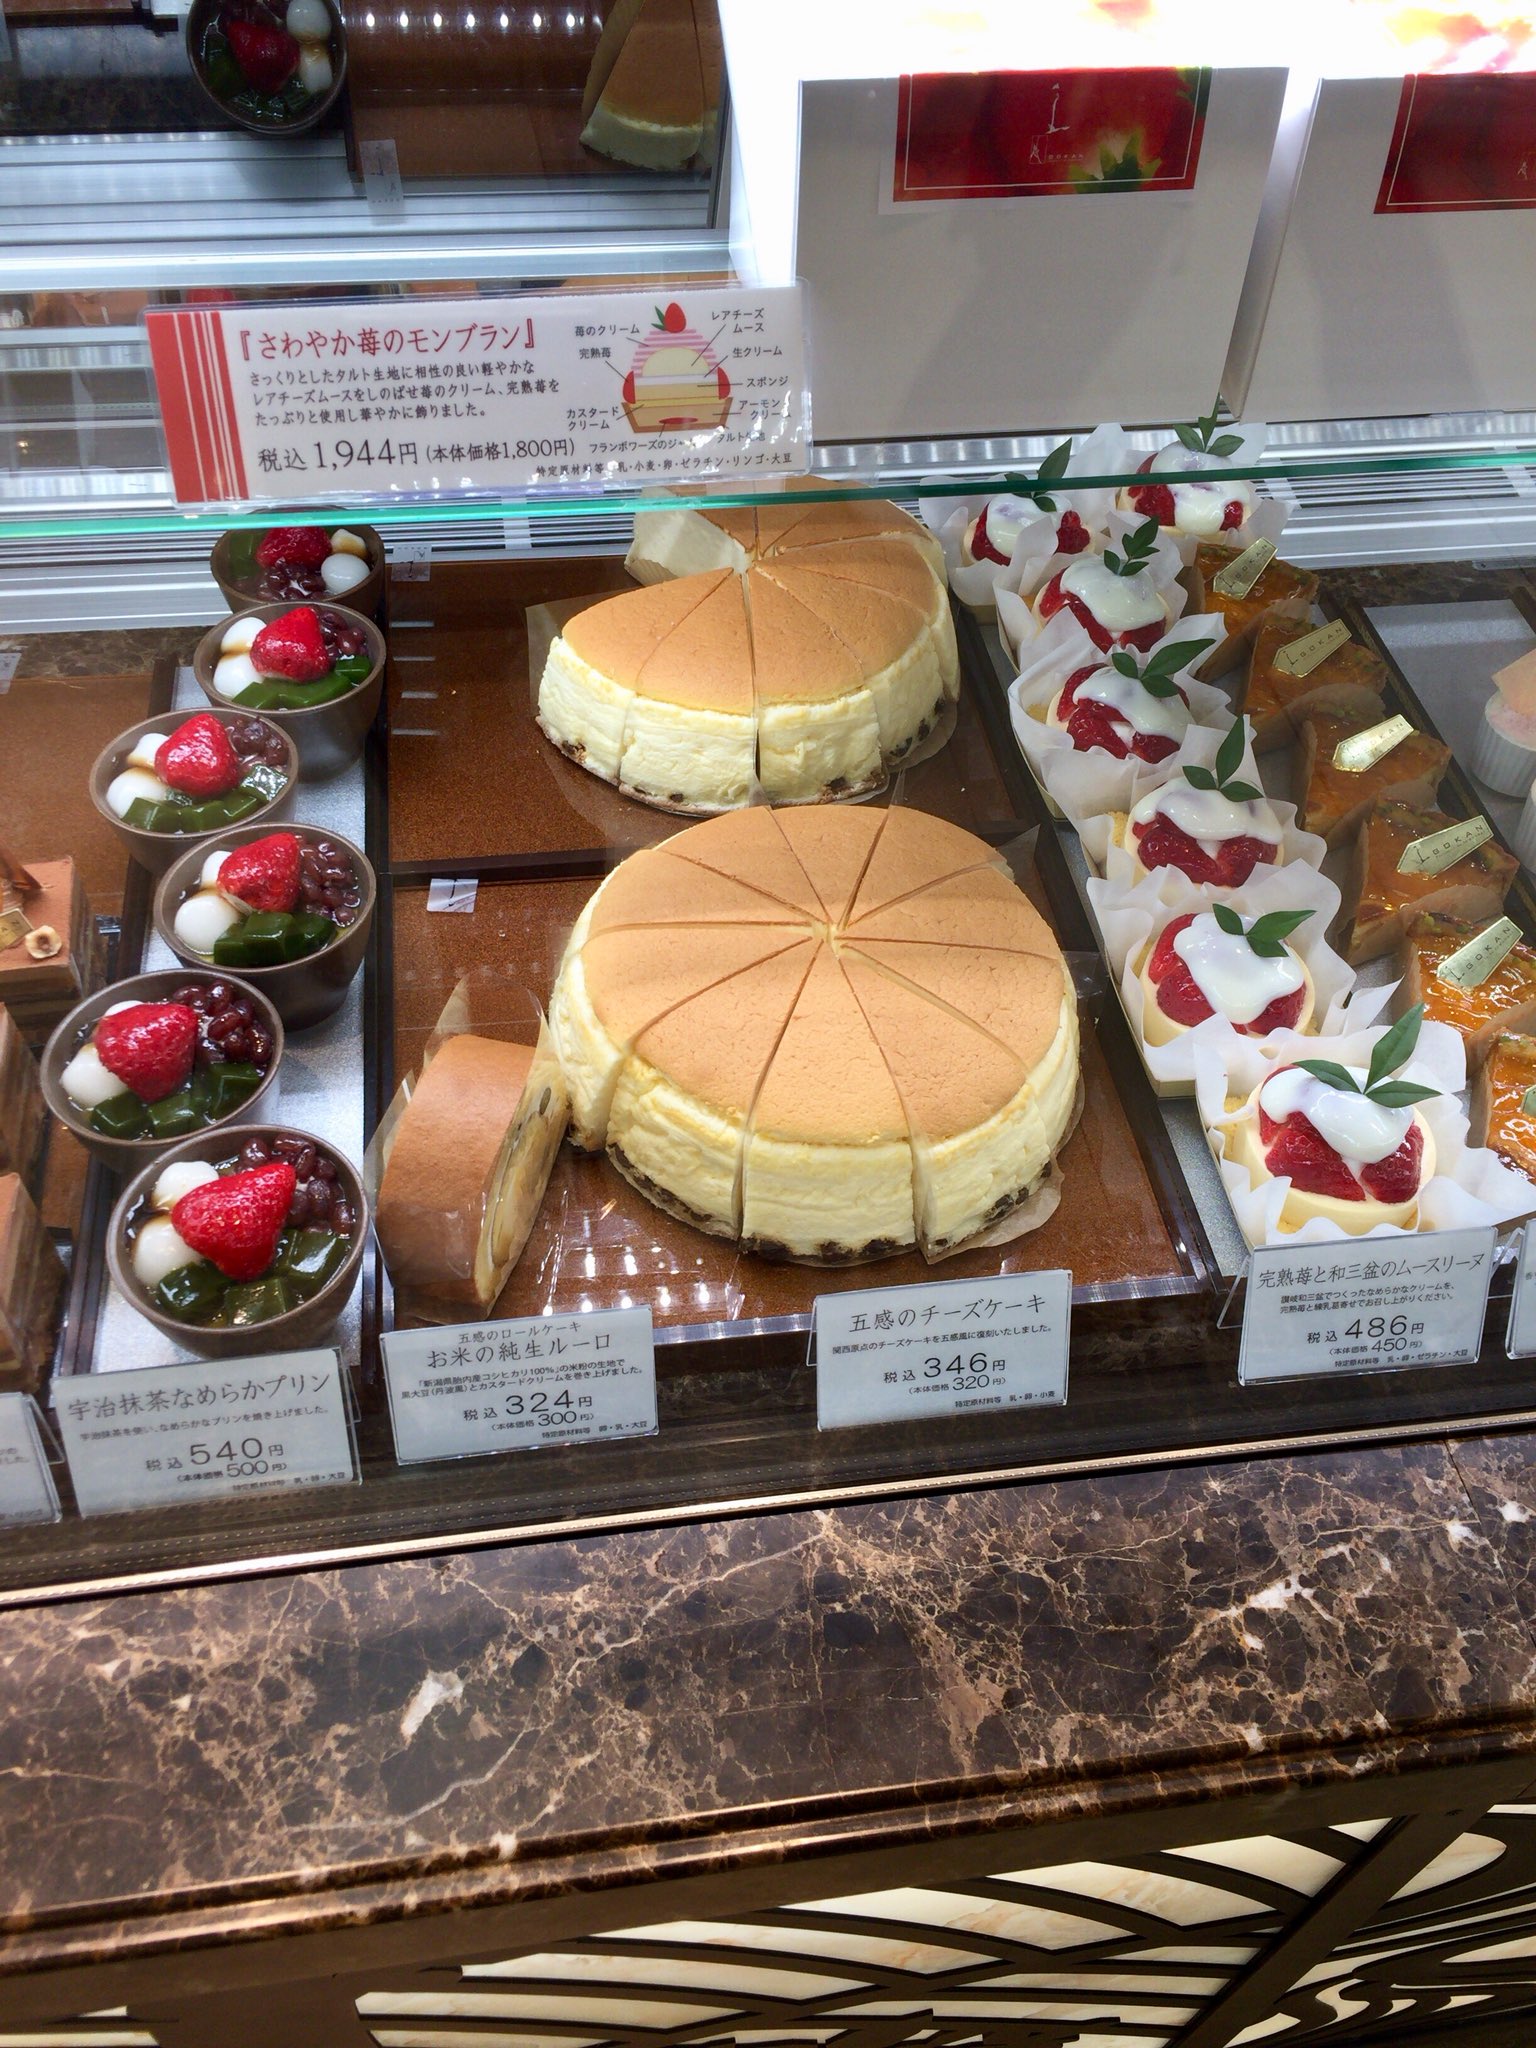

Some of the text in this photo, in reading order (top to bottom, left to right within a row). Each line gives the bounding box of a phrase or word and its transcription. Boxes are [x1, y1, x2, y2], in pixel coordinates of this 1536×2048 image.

[711, 307, 765, 321] レアチーズ
[240, 318, 535, 361] 『さわやか苺のモンブラン』
[575, 324, 640, 337] 苺のクリーム
[733, 322, 765, 333] ムース
[579, 346, 612, 360] 完熟苺
[732, 345, 783, 358] 生クリーム
[250, 359, 535, 387] さっくりとしたタルト生地に相性の良い軽やかな
[746, 375, 789, 388] スポンジ
[253, 377, 560, 406] レアチーズムースをしのばせ苺のクリーム、完熟苺を
[255, 401, 487, 427] たっぷりと使用し華やかに飾りました。
[566, 405, 620, 420] カスタード
[568, 419, 610, 432] クリーム
[1432, 824, 1483, 856] GOKAN
[1465, 926, 1511, 970] GOKAN
[1256, 1252, 1486, 1290] 完熟苺と和三盆のムースリーヌ
[848, 1293, 1046, 1333] 五感のチーズケーキ
[458, 1321, 582, 1345] 五感のロールケーキ
[427, 1333, 612, 1370] お米の純生ルーロ
[67, 1373, 331, 1422] 宇治抹茶なめらかプリン
